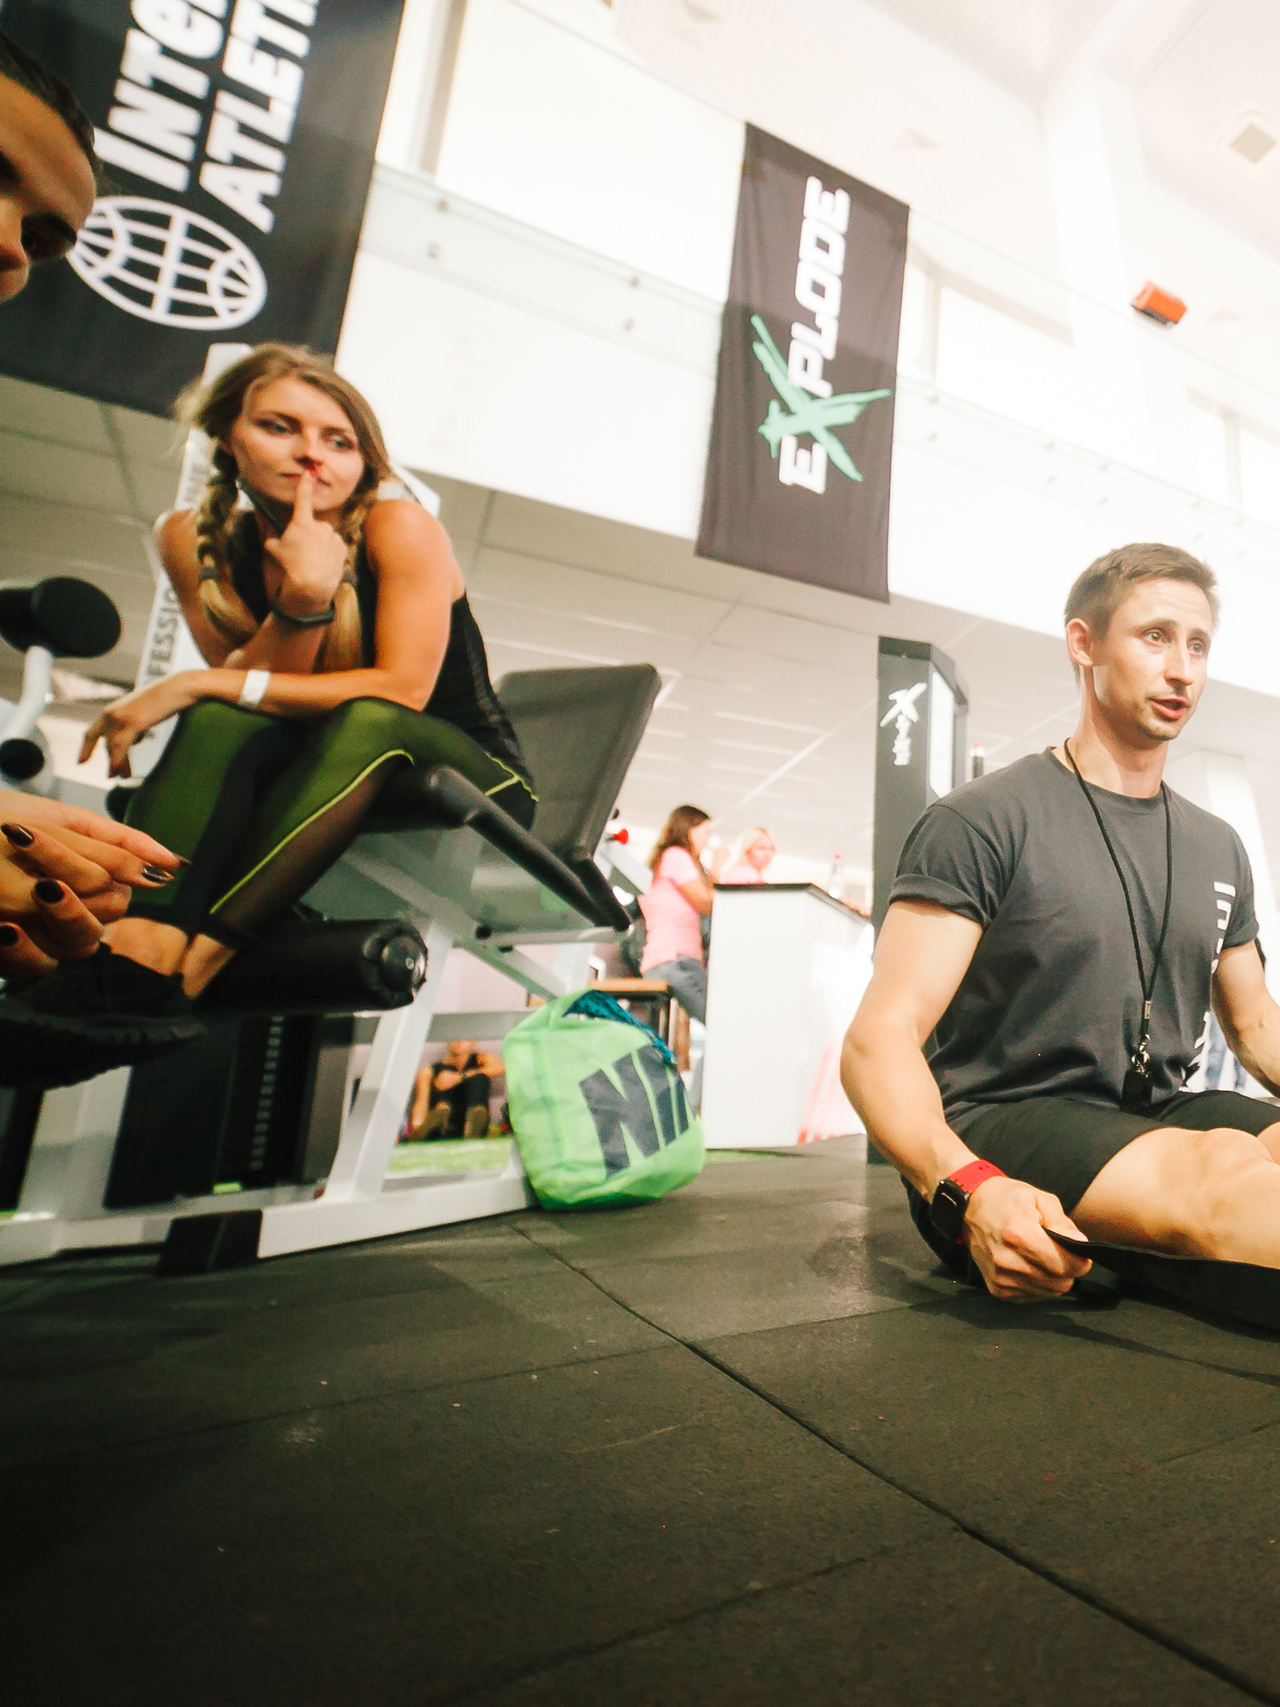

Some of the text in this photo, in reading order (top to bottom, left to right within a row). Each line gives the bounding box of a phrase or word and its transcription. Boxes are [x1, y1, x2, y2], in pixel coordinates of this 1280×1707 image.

[93, 0, 230, 192] INTe
[199, 0, 319, 234] ATLETI
[752, 176, 892, 494] EXPLODE
